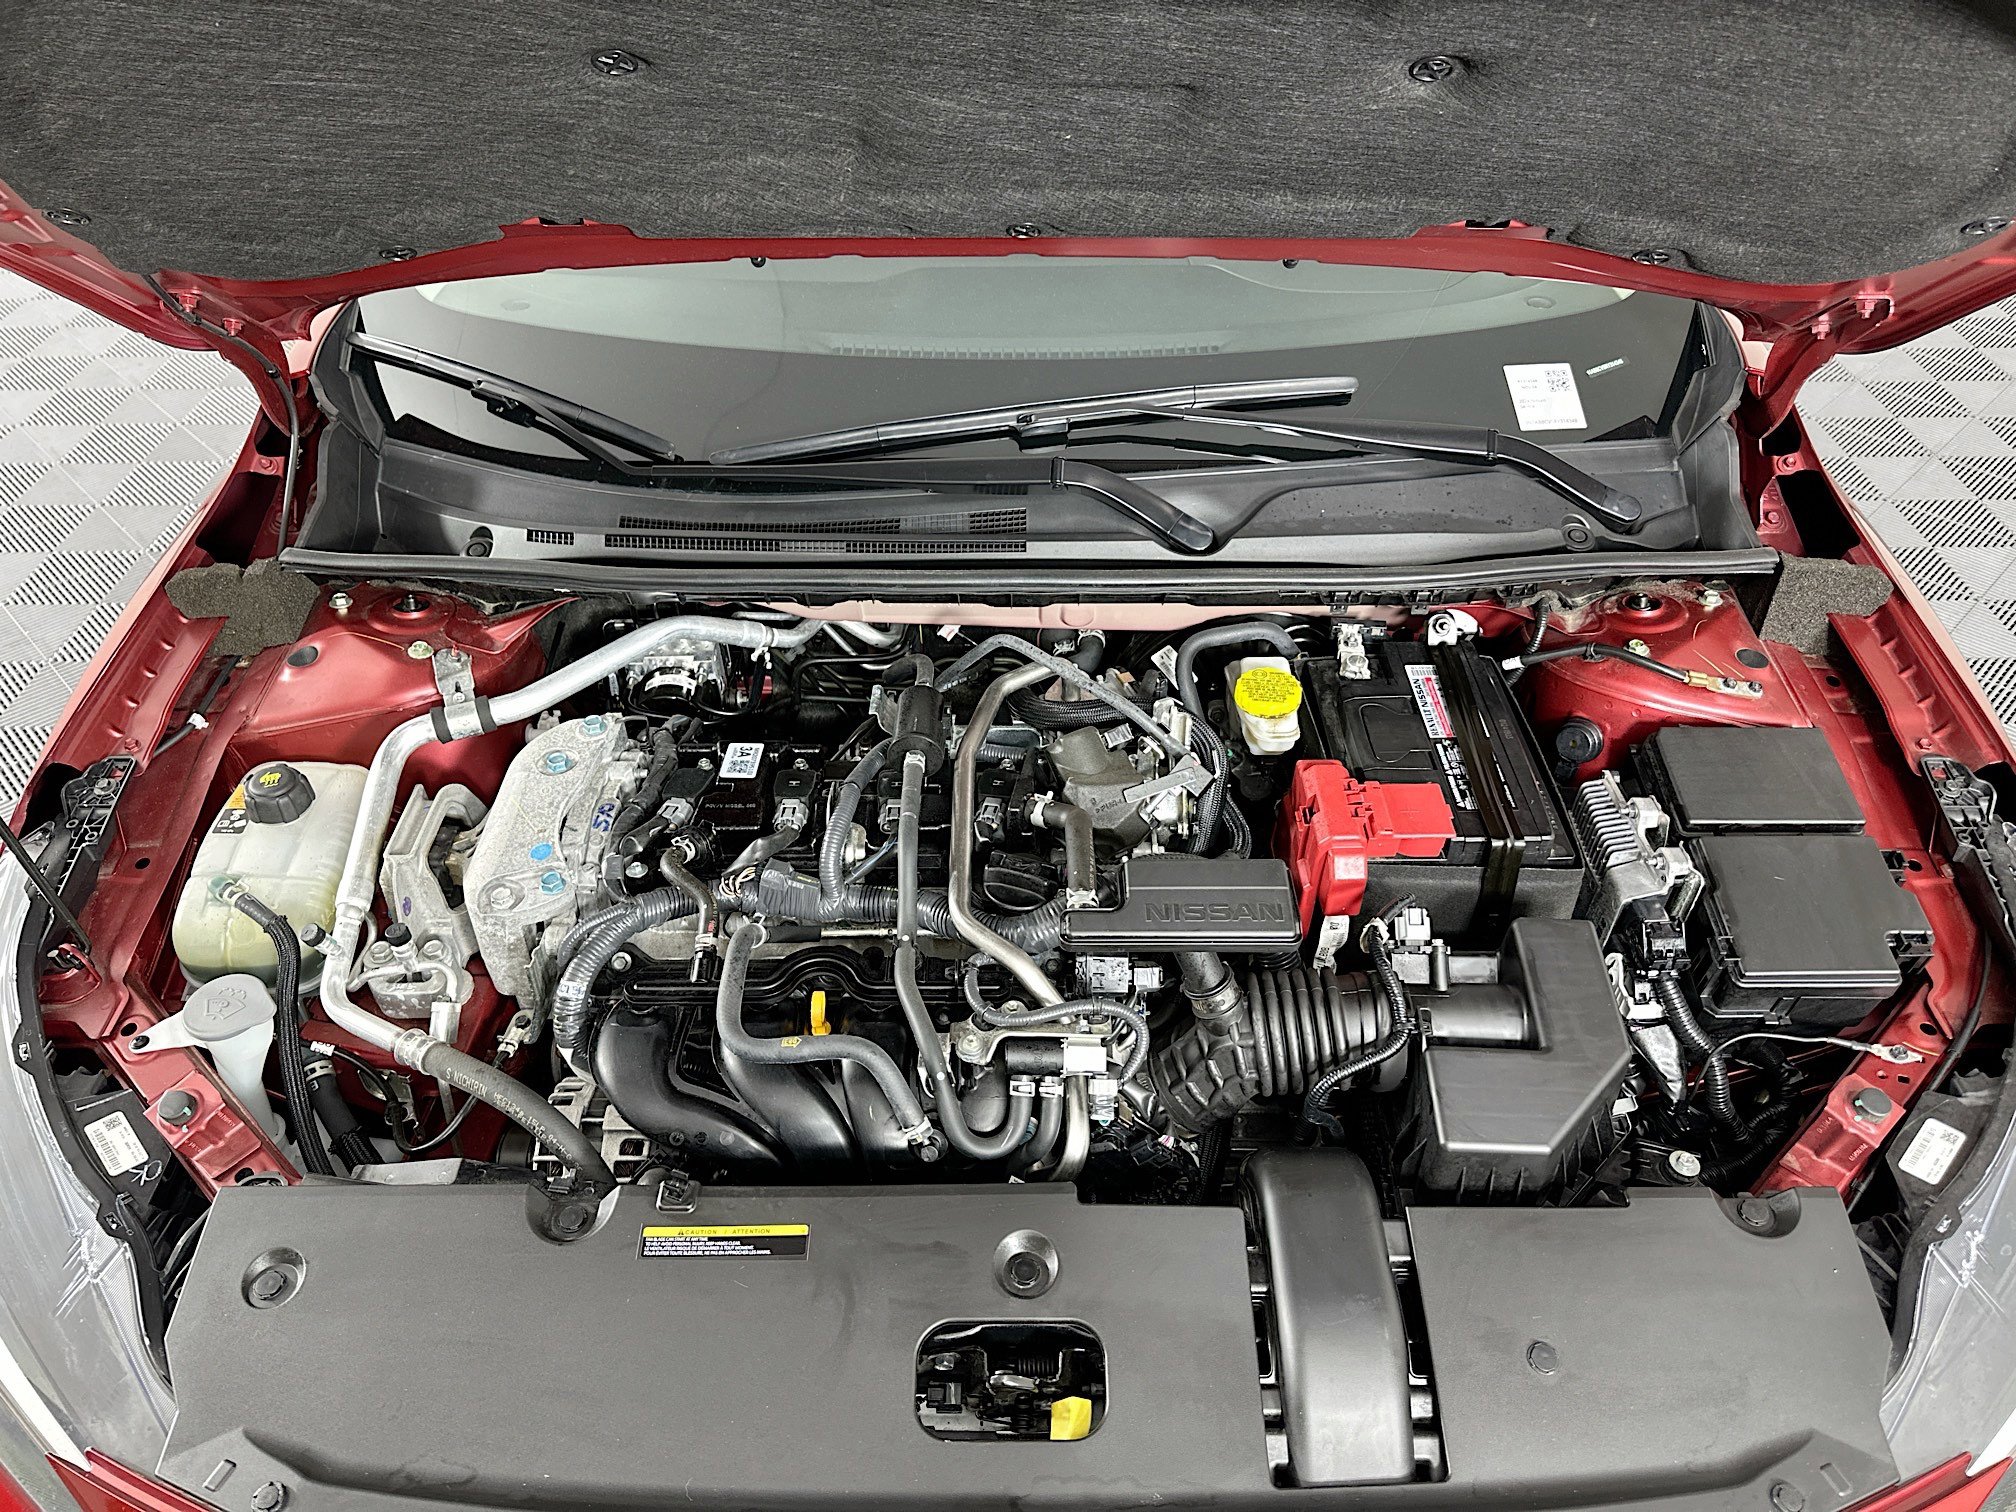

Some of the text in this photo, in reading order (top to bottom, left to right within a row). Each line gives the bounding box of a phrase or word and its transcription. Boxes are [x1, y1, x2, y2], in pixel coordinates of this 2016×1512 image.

[1412, 678, 1430, 708] NISSAN
[737, 746, 753, 758] 3A
[1145, 902, 1286, 922] NISSAN
